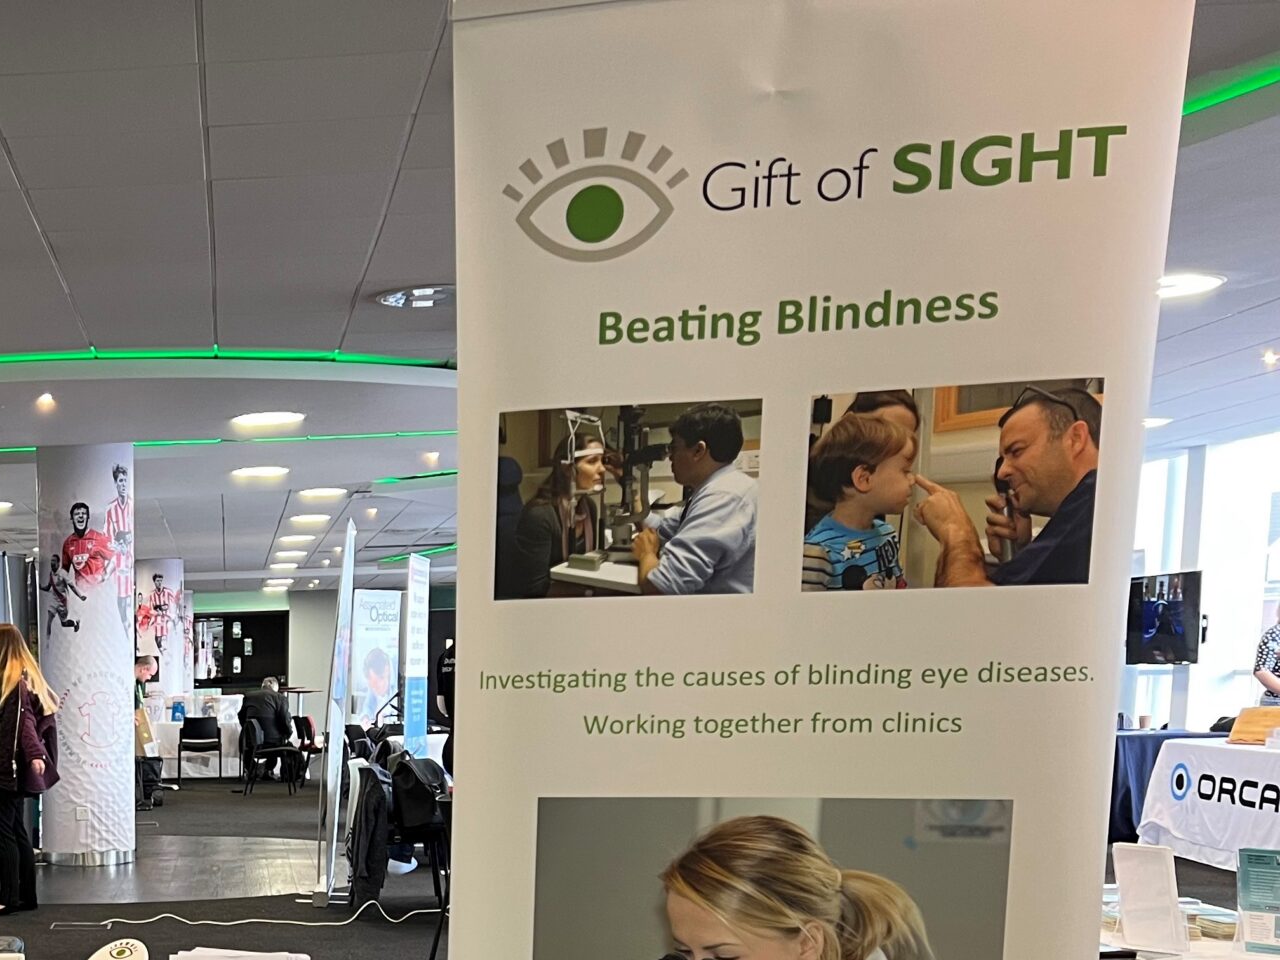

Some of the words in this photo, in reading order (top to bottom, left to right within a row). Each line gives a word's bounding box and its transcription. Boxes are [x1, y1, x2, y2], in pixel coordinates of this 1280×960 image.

[702, 157, 802, 212] Gift
[817, 147, 878, 204] of
[892, 125, 1127, 194] SIGHT
[598, 303, 762, 347] Beating
[777, 290, 999, 335] Blindness
[479, 667, 627, 692] Investigating
[634, 664, 676, 688] the
[683, 670, 766, 688] causes
[774, 663, 801, 686] of
[808, 662, 911, 689] blinding
[920, 668, 968, 688] eye
[977, 660, 1095, 684] diseases.
[583, 714, 686, 739] Working
[694, 711, 803, 739] together
[810, 712, 872, 734] from
[882, 710, 962, 734] clinics
